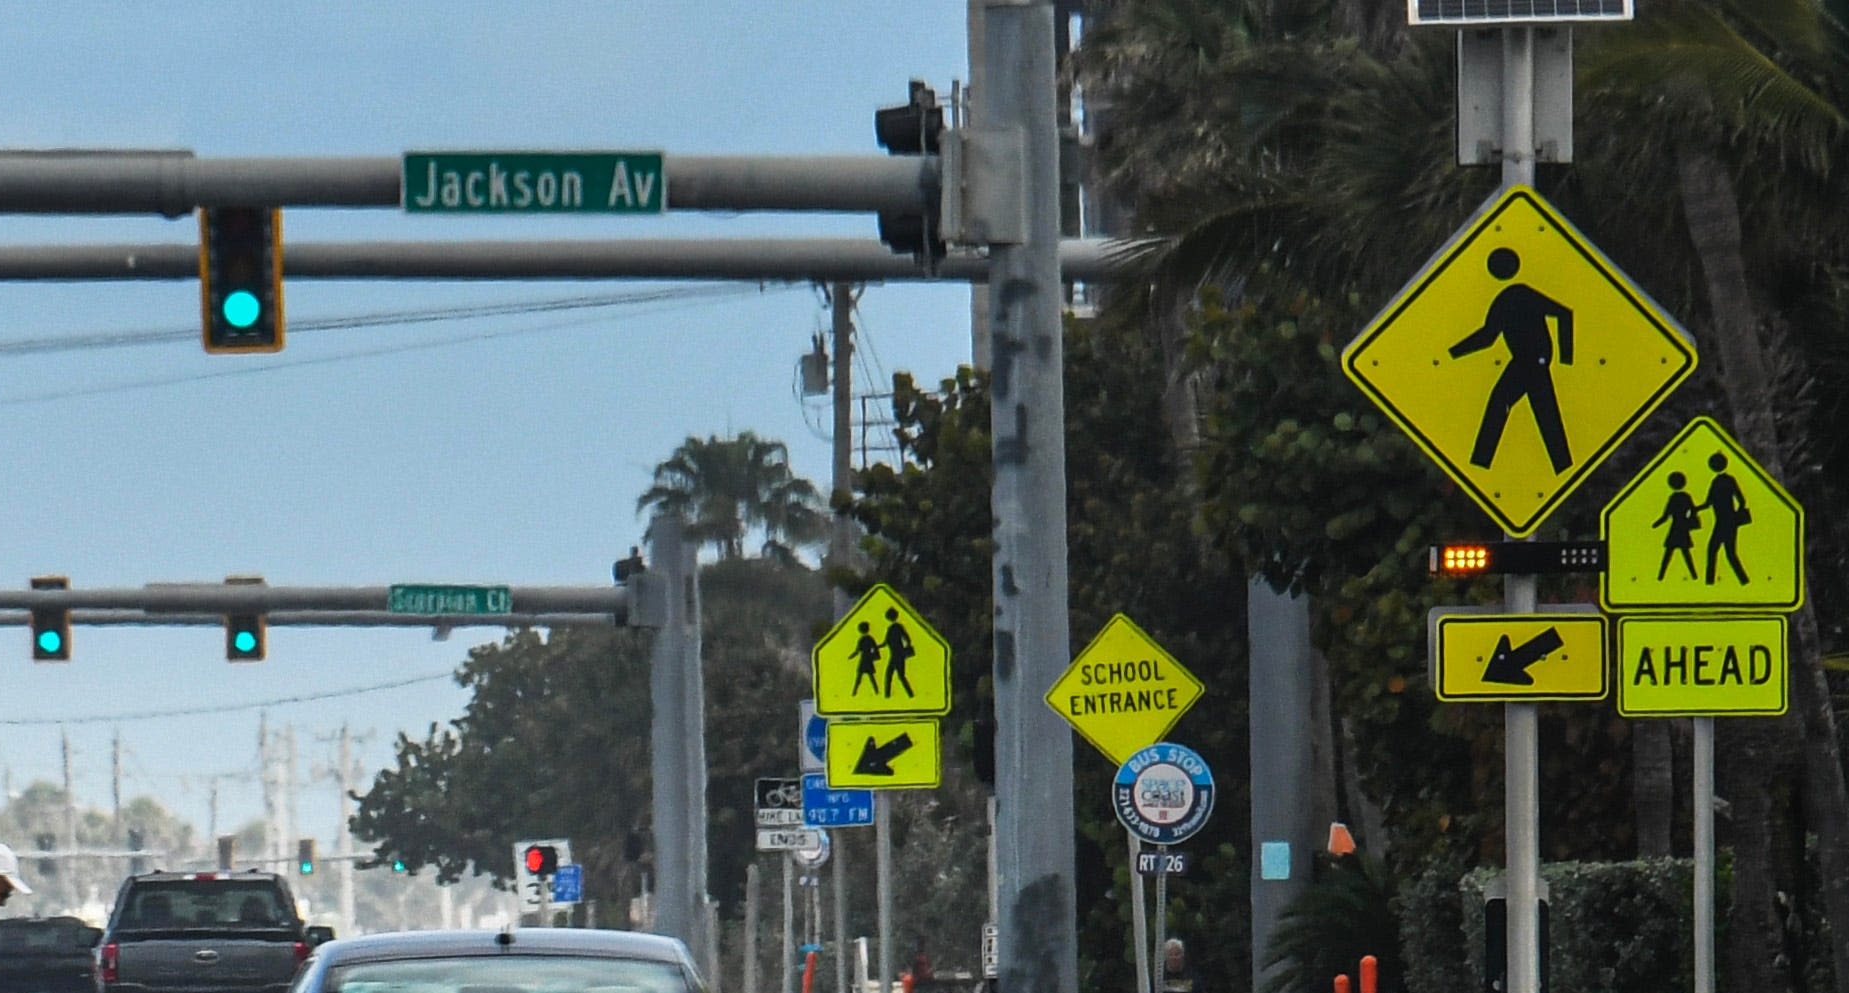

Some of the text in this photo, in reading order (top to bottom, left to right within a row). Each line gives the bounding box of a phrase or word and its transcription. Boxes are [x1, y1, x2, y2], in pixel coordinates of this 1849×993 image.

[415, 160, 655, 207] Jackson Av
[1080, 660, 1165, 686] SCHOOL
[1632, 645, 1772, 686] AHEAD
[1069, 688, 1179, 716] ENTRANCE
[1128, 748, 1204, 776] BUS STOP
[848, 807, 869, 822] FM
[769, 833, 807, 846] ENDS
[1139, 854, 1184, 872] RT 26
